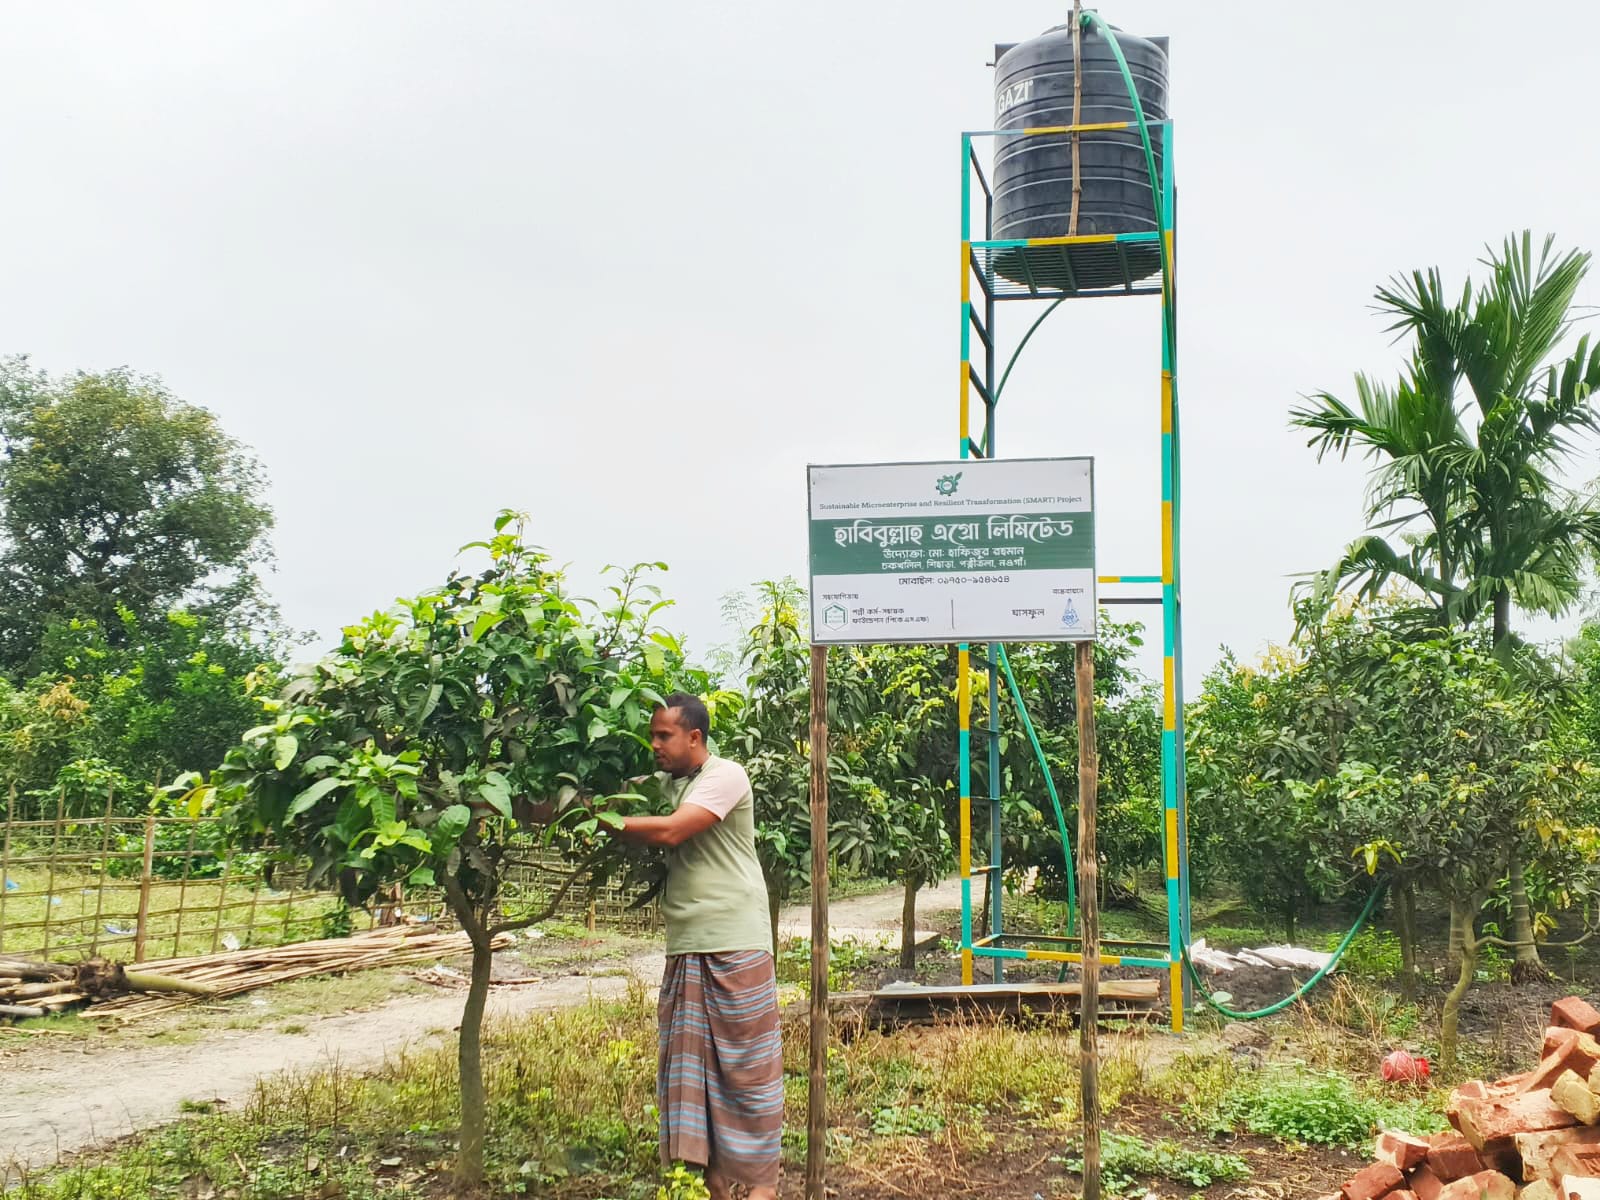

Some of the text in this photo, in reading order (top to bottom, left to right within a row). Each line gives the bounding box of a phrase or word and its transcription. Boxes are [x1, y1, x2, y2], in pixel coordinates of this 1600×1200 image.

[998, 80, 1029, 115] GAZI
[861, 501, 917, 509] Microenterprise
[933, 499, 964, 507] Resilient
[966, 498, 1021, 506] Transformation
[1057, 496, 1082, 504] Project
[833, 514, 1074, 547] হাবিবুল্লাহ এগ্রো লিমিটেড
[948, 546, 990, 559] হাফিজুর
[992, 546, 1025, 556] রহমান
[1011, 608, 1045, 619] ঘাসফুল
